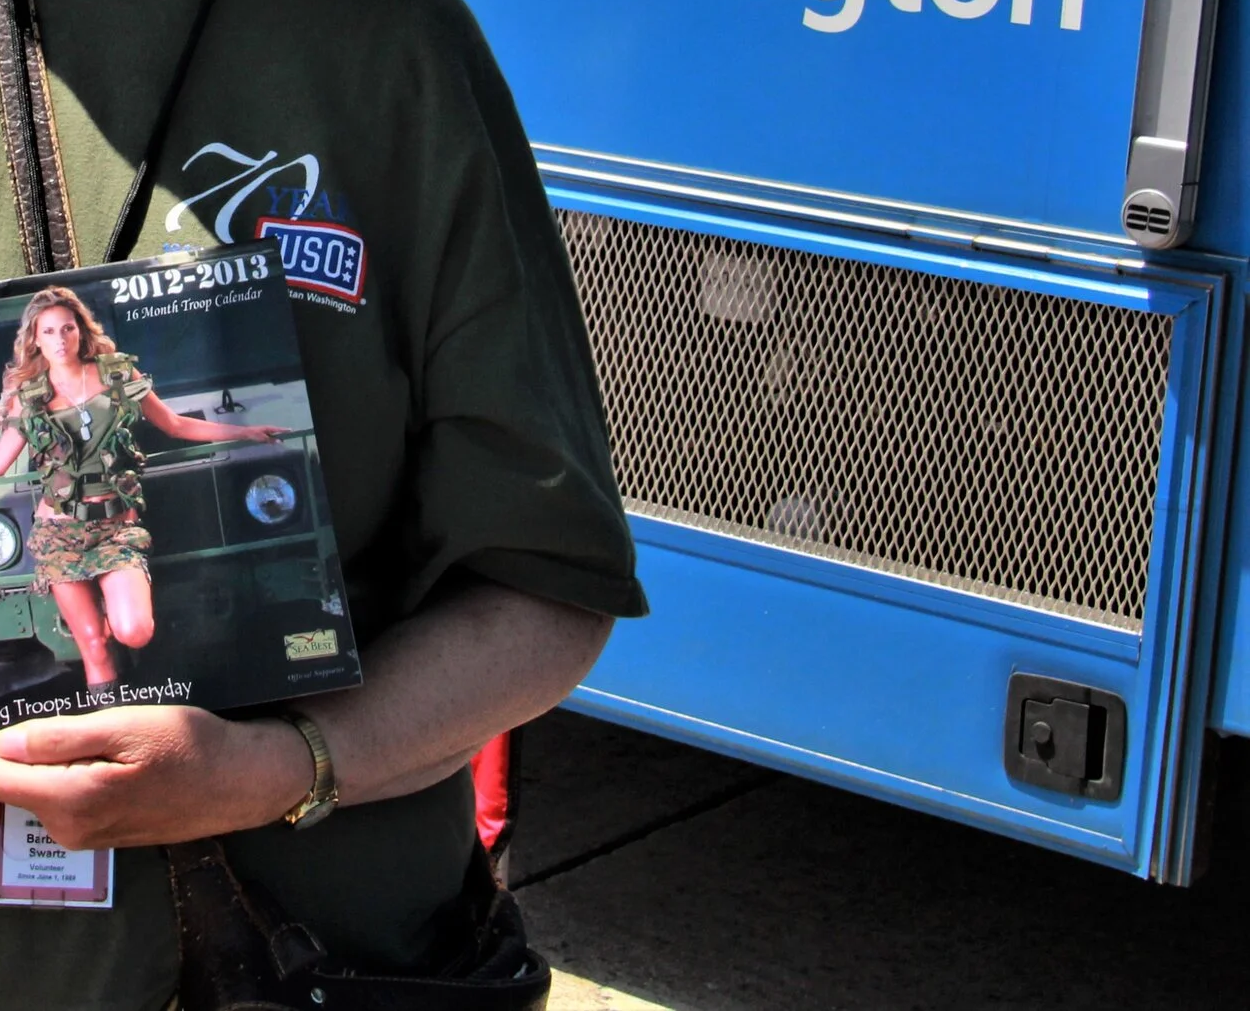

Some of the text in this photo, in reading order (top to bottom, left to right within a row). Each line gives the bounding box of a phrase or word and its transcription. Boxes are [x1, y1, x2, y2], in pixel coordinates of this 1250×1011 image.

[280, 233, 344, 279] USO
[111, 254, 269, 304] 2012-2013
[126, 287, 263, 322] 16 Month Troop Calendar
[306, 292, 357, 314] Washington
[13, 697, 72, 717] Troops
[75, 687, 116, 709] Lives
[121, 677, 192, 704] Everyday
[26, 833, 57, 845] Barb
[29, 848, 66, 858] Swartz
[30, 863, 65, 872] Volunteer
